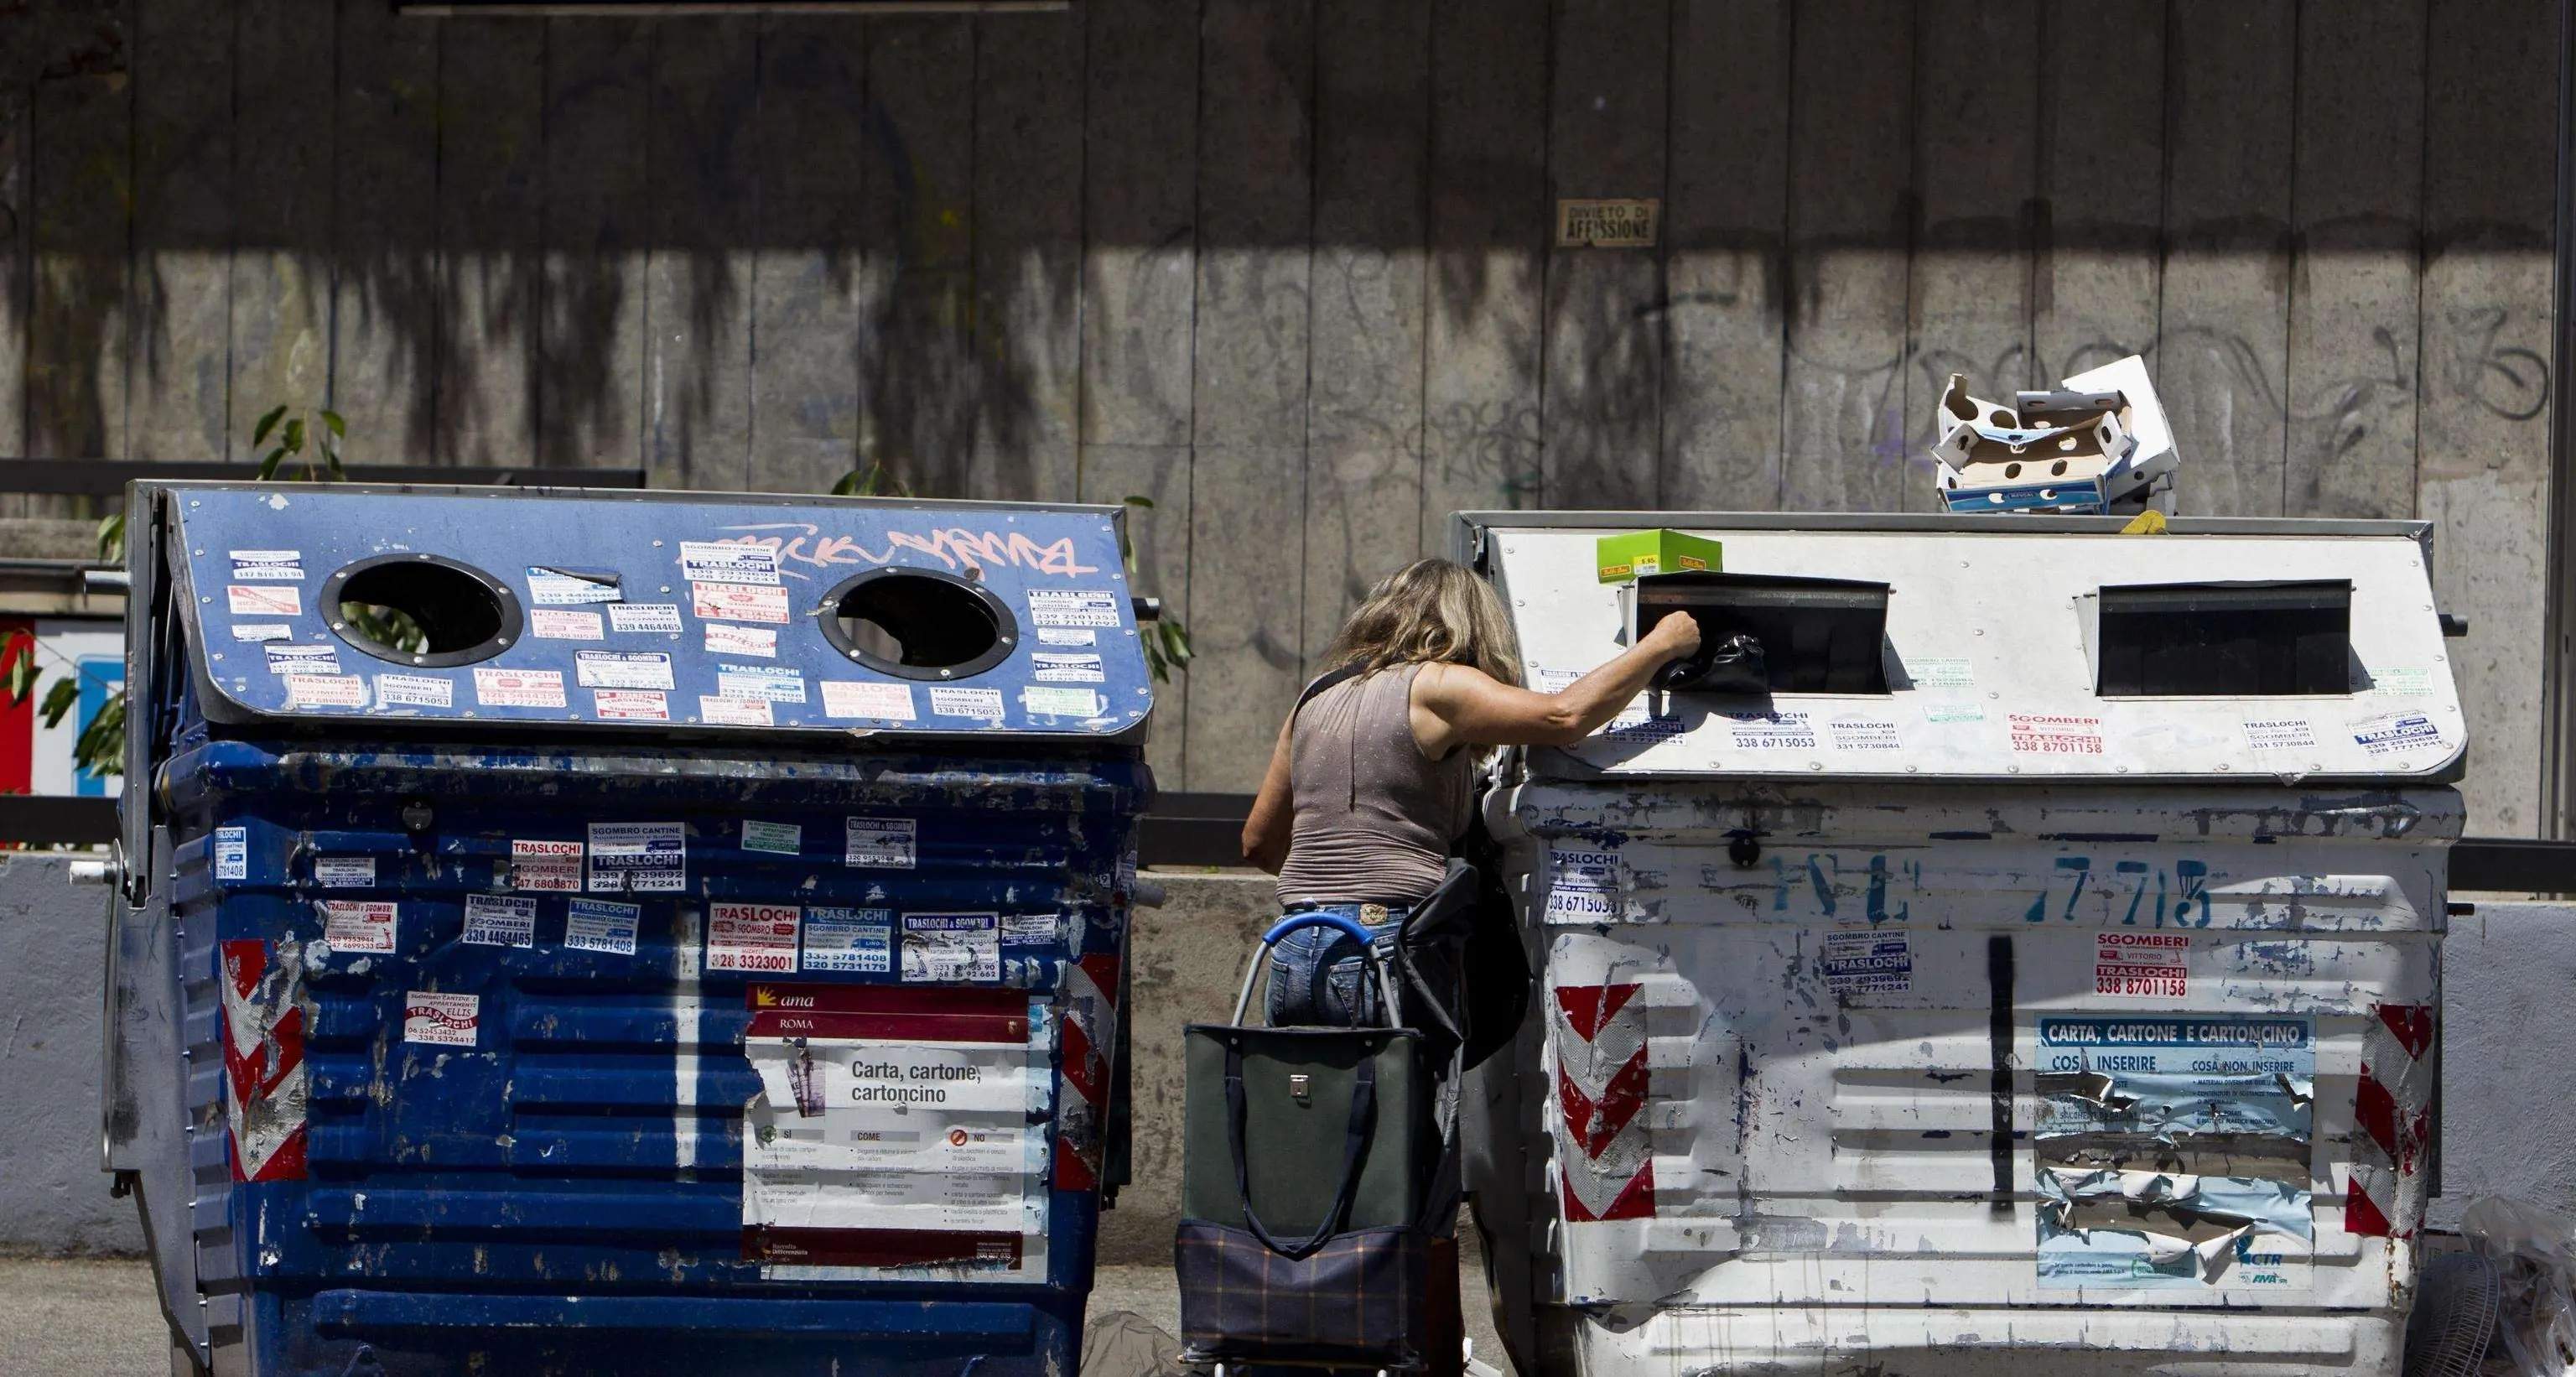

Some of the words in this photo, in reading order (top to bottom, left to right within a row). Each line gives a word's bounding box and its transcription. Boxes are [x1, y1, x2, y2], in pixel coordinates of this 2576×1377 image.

[1568, 205, 1625, 218] DIVIETO
[1566, 219, 1649, 239] AFFISSIONE
[689, 560, 773, 571] TRASLOCHI
[1030, 590, 1112, 599] TRASLOCHI
[637, 623, 681, 631] 4464465
[268, 653, 335, 662] TRASLOCHI
[579, 652, 621, 661] TRASLOCHI
[628, 654, 662, 663] SGOMBRI
[476, 671, 560, 679] TRASLOCHI
[719, 663, 800, 676] TRASLOCHI
[291, 676, 359, 685] TRASLOCHI
[385, 675, 451, 685] TRASLOCHI
[383, 693, 402, 702] 338
[405, 694, 449, 705] 6715053
[958, 706, 1002, 716] 6715053
[1729, 711, 1809, 720] TRASLOCHI
[2008, 714, 2100, 725] SGOMBERI
[2242, 720, 2308, 730] TRASLOCHI
[2357, 725, 2436, 741] TRASLOCHI
[1736, 738, 1758, 747] 338
[1762, 738, 1815, 747] 6715053
[2012, 734, 2102, 744] TRASLOCHI
[2013, 741, 2038, 751] 338
[2043, 742, 2103, 754] 8701158
[849, 819, 880, 829] TRASLOCHI
[591, 827, 640, 835] SGOMBRO
[513, 843, 581, 855] TRASLOCHI
[596, 855, 678, 866] TRASLOCHI
[1550, 851, 1618, 865] TRASLOCHI
[515, 865, 579, 874] GOMBERI
[631, 871, 683, 880] 939692
[534, 879, 579, 890] 6808870
[328, 903, 360, 912] TRASLOCHI
[365, 904, 393, 913] SGOMBRI
[470, 896, 535, 909] TRASLOCHI
[574, 901, 635, 915] TRASLOCHI
[1566, 896, 1618, 913] 6715053
[713, 907, 797, 922] TRASLOCHI
[808, 908, 888, 921] TRASLOCHI
[470, 917, 530, 928] SGOMBERI
[907, 917, 948, 929] TRASLOCHI
[737, 923, 771, 935] SGOMBRO
[808, 924, 850, 933] SGOMBRO
[465, 928, 486, 942] 339
[487, 930, 531, 946] 4464465
[1827, 933, 1870, 941] SGOMBRO
[1871, 931, 1906, 939] CANTINE
[2097, 933, 2189, 947] SGOMBERI
[567, 935, 586, 948] 333
[589, 937, 633, 953] 5781408
[711, 954, 735, 968] 328
[739, 954, 792, 970] 3323001
[832, 953, 887, 962] 5781408
[2127, 952, 2163, 961] VITTORIO
[832, 962, 887, 971] 5731179
[1830, 956, 1909, 971] TRASLOCHI
[2097, 966, 2186, 978] TRASLOCHI
[2096, 977, 2122, 994] 338
[2127, 978, 2186, 996] 8701158
[781, 995, 815, 1007] ama
[409, 1007, 473, 1029] TRASLOCHI
[446, 1008, 471, 1017] ELLIS
[780, 1019, 814, 1029] ROMA
[437, 1036, 475, 1044] 5324417
[2049, 1025, 2101, 1044] CARTA,
[2107, 1025, 2178, 1042] CARTONE
[2186, 1026, 2195, 1042] E
[2199, 1025, 2300, 1043] CARTONCINO
[2052, 1055, 2089, 1072] COS
[2097, 1056, 2157, 1072] INSERIRE
[2192, 1060, 2220, 1073] COSA
[2223, 1061, 2250, 1073] NON
[2252, 1061, 2295, 1073] INSERIRE
[852, 1060, 904, 1082] Carta,
[909, 1063, 982, 1084] cartone,
[851, 1085, 947, 1104] cartoncino
[857, 1132, 880, 1141] COME
[974, 1134, 985, 1142] NO
[2251, 1254, 2283, 1266] CTR
